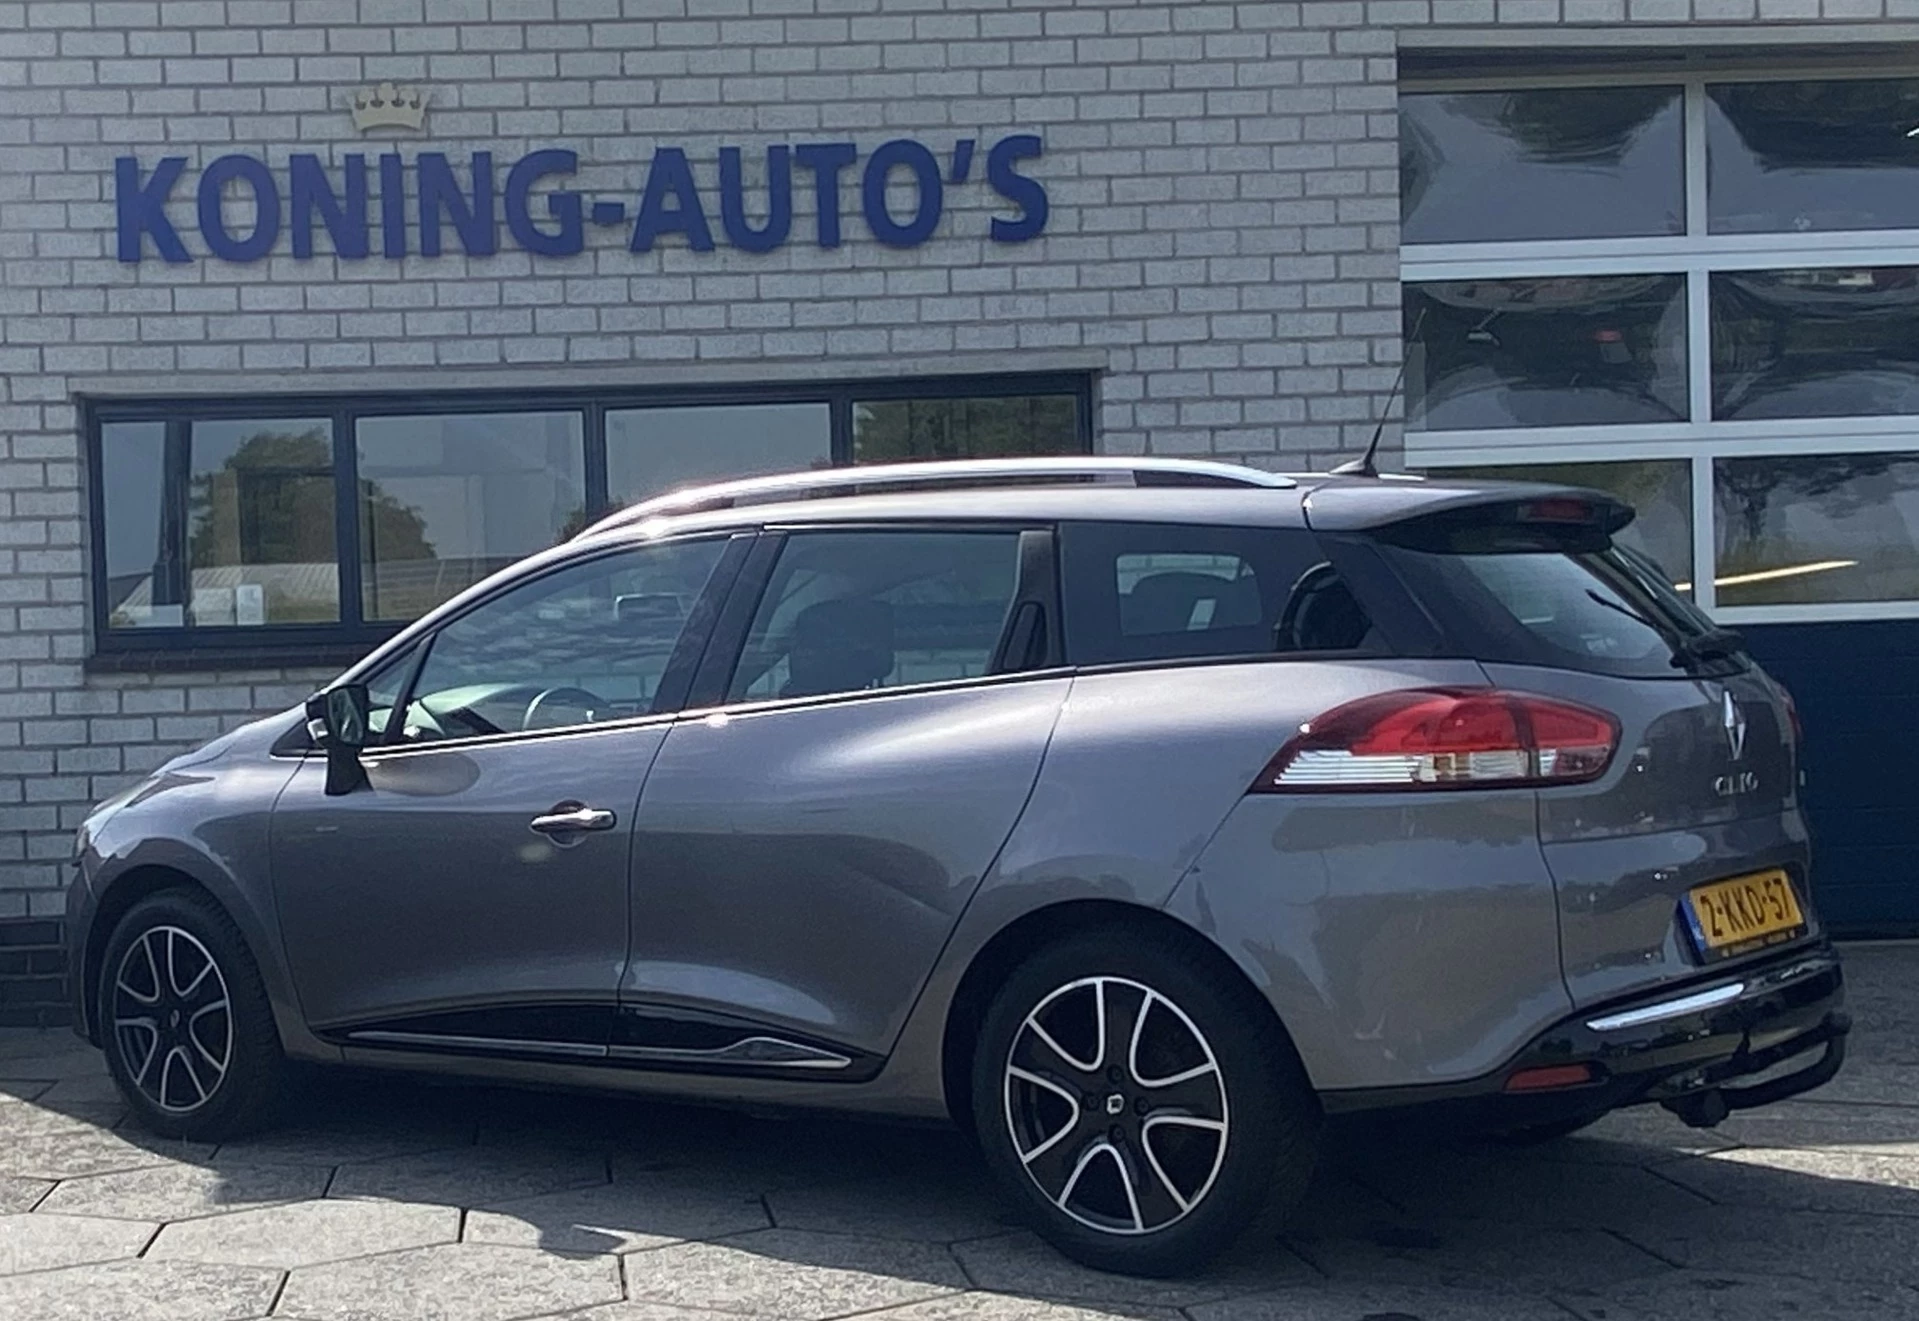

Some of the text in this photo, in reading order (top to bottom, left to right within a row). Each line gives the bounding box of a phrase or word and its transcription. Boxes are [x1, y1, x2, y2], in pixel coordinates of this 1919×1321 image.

[115, 131, 1050, 263] KONING-AUTO'S
[1714, 771, 1759, 796] CLIO
[1700, 878, 1791, 936] 2-KKD-57
